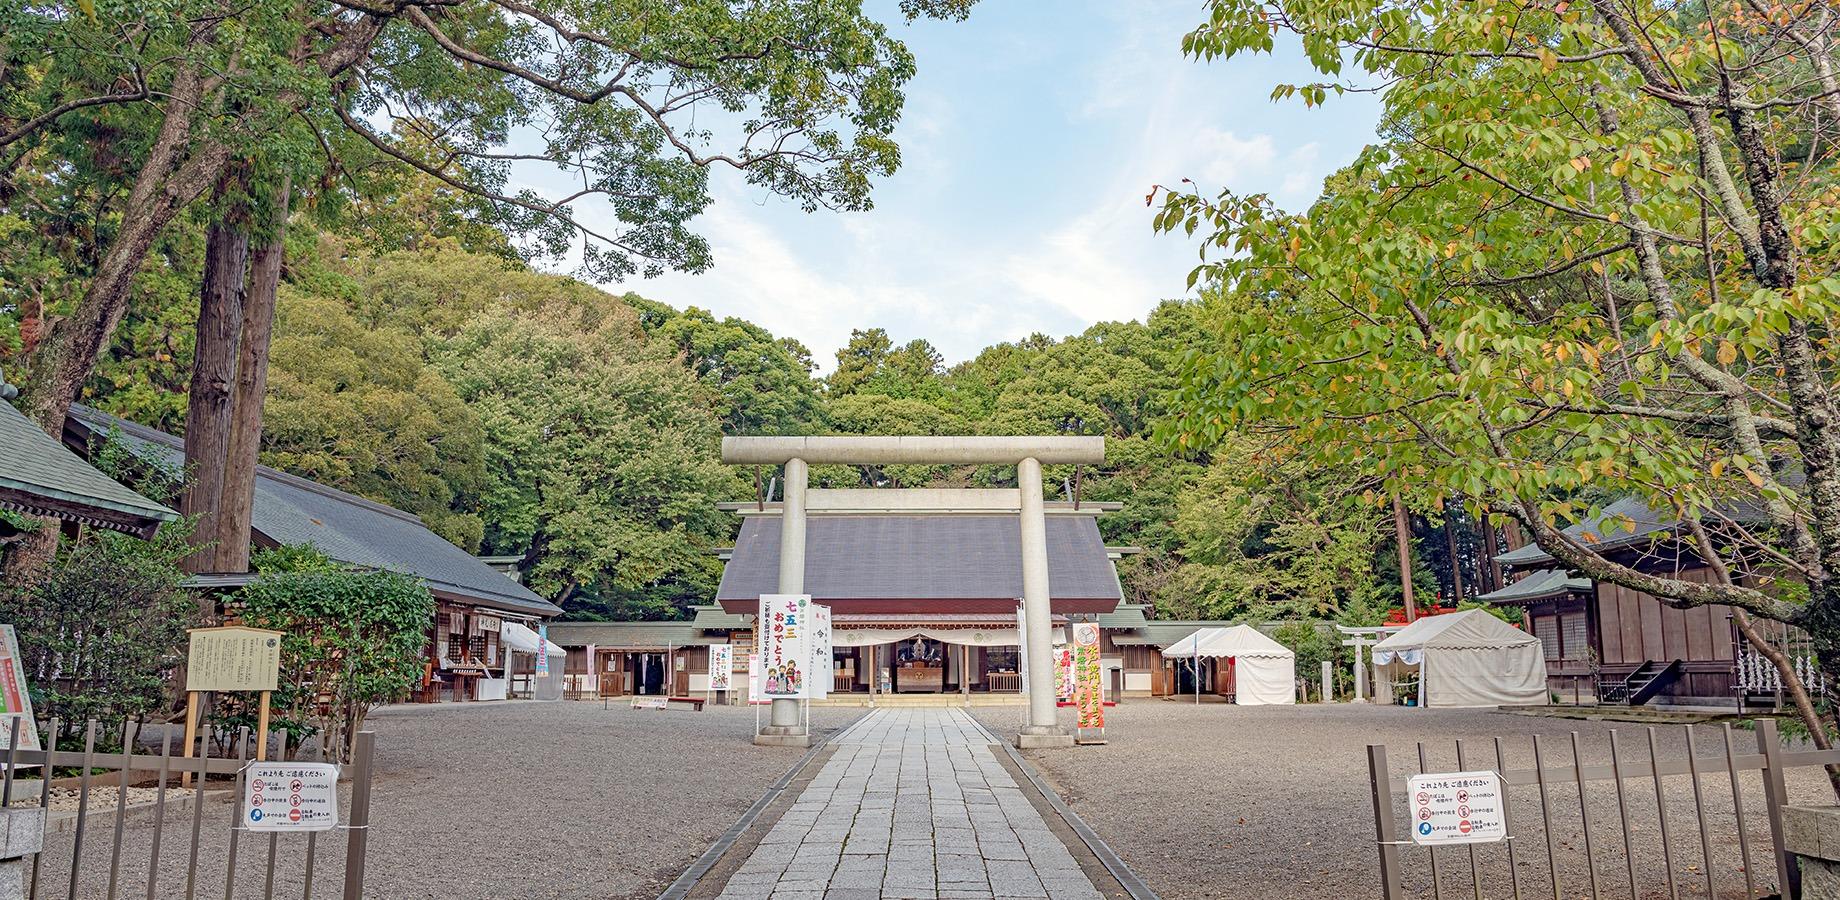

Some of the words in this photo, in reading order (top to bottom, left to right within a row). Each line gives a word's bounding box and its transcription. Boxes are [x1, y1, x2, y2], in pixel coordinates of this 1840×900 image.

[785, 601, 797, 638] 七五三
[774, 611, 784, 666] おめでとう
[816, 629, 824, 656] 令和
